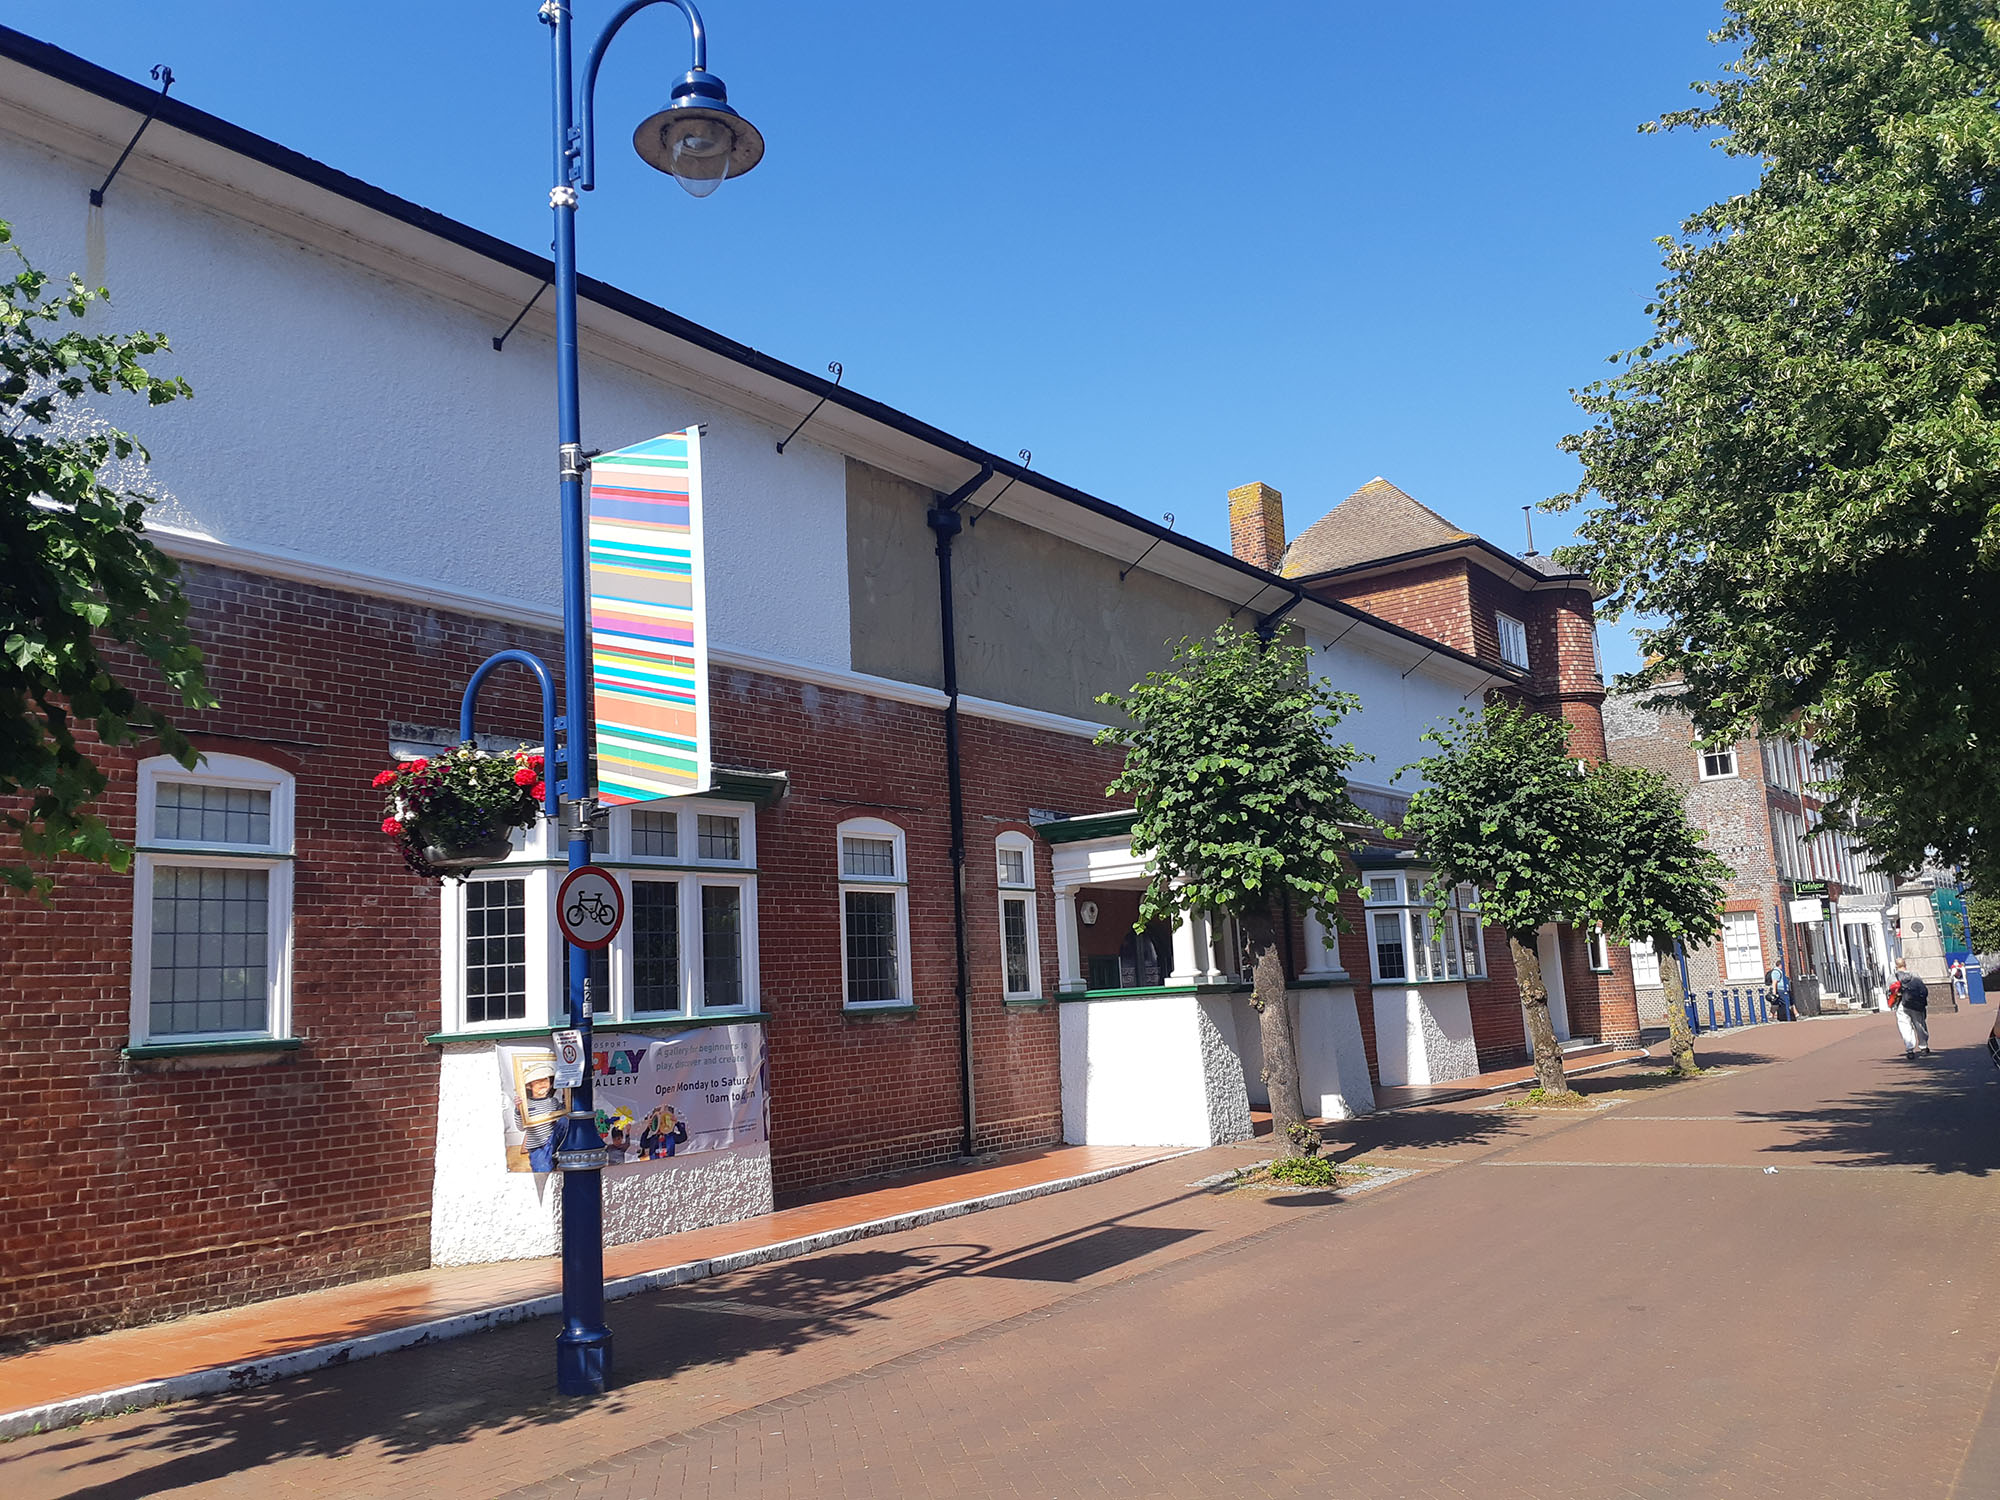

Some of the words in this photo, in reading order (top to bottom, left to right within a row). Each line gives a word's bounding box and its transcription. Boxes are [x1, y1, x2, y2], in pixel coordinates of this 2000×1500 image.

[593, 1041, 627, 1049] OSPORT
[656, 1048, 662, 1057] A
[664, 1046, 689, 1058] gallery
[699, 1042, 739, 1054] beginners
[740, 1042, 748, 1050] to
[656, 1061, 674, 1072] play,
[703, 1056, 717, 1065] and
[718, 1055, 745, 1064] create
[595, 1076, 639, 1087] ALLERY
[655, 1084, 676, 1096] Open
[676, 1080, 709, 1092] Monday
[710, 1079, 719, 1088] to
[705, 1093, 729, 1104] 10am
[732, 1092, 740, 1101] to
